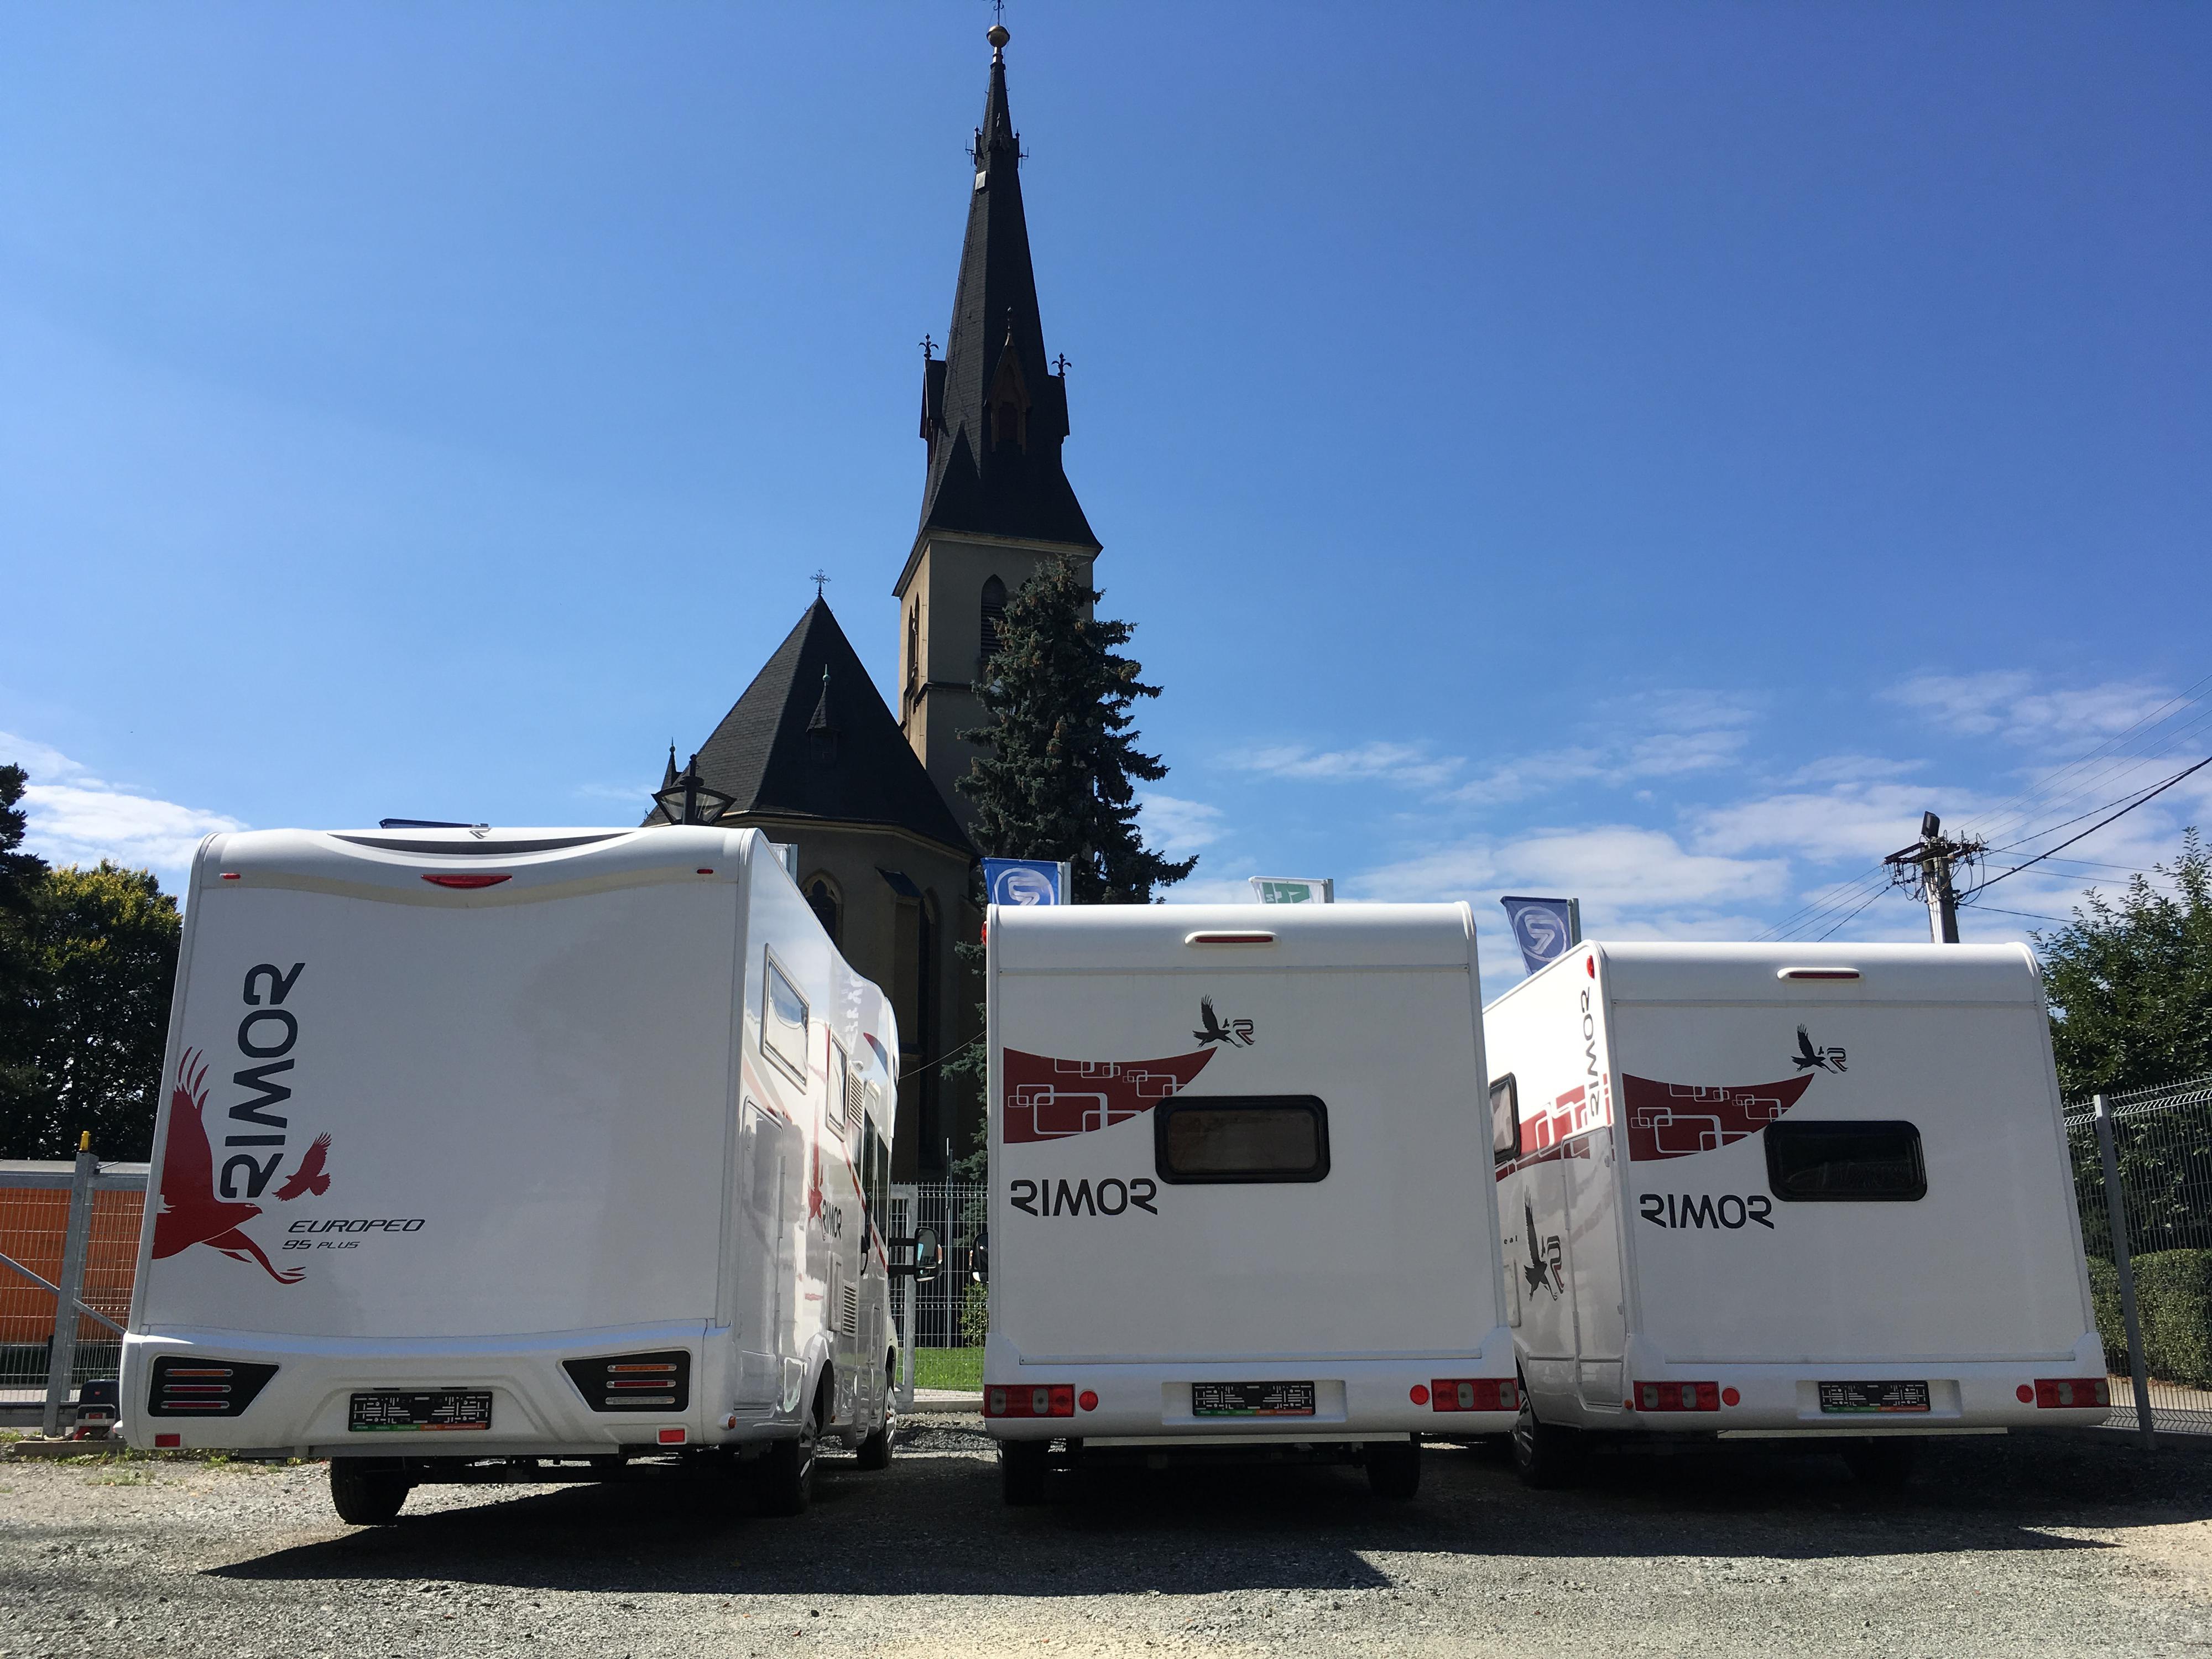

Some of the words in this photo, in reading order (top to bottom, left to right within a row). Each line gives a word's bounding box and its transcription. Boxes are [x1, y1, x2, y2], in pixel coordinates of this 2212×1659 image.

[1580, 986, 1599, 1117] RIMOR
[219, 962, 306, 1198] RIMOR
[1010, 1178, 1159, 1216] RIMOR
[1640, 1194, 1775, 1229] RIMOR
[288, 1219, 426, 1233] EUROPEO
[822, 1199, 842, 1240] RIMOR
[282, 1239, 311, 1250] 95
[316, 1241, 361, 1249] PLUS
